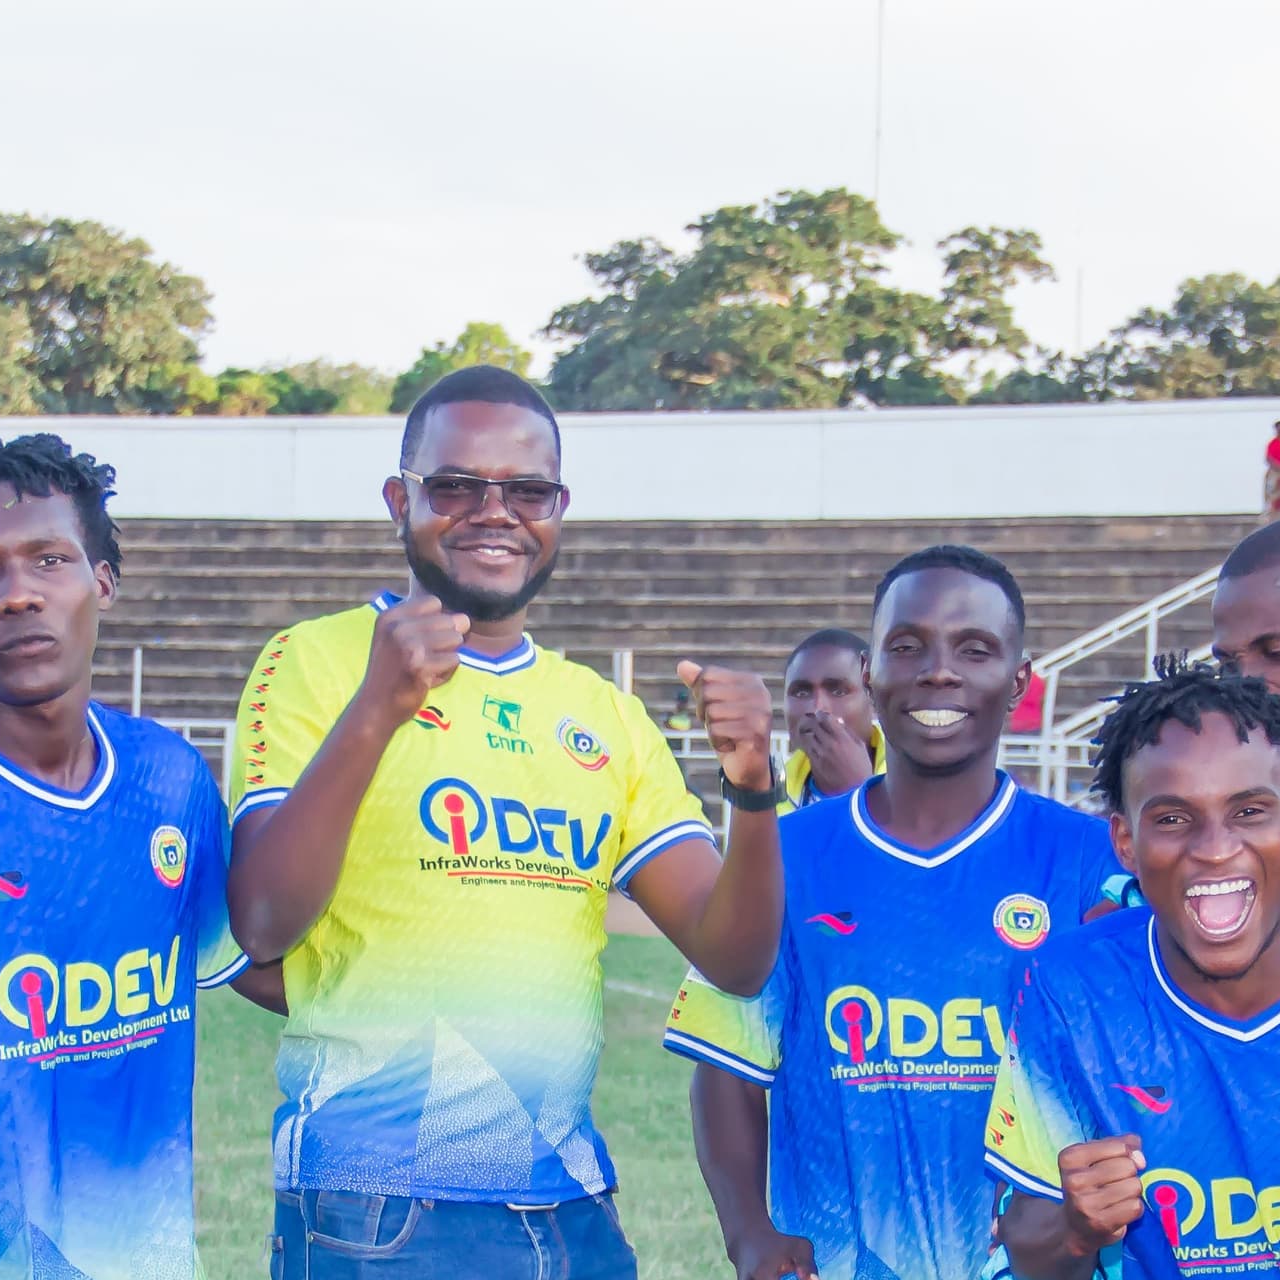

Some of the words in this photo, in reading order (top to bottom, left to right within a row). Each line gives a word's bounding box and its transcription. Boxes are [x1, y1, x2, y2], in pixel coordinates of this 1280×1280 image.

[486, 732, 534, 755] tnm
[420, 855, 511, 871] InfraWorks
[82, 1012, 168, 1043] Development
[170, 1005, 190, 1023] Ltd
[1225, 1263, 1245, 1274] and
